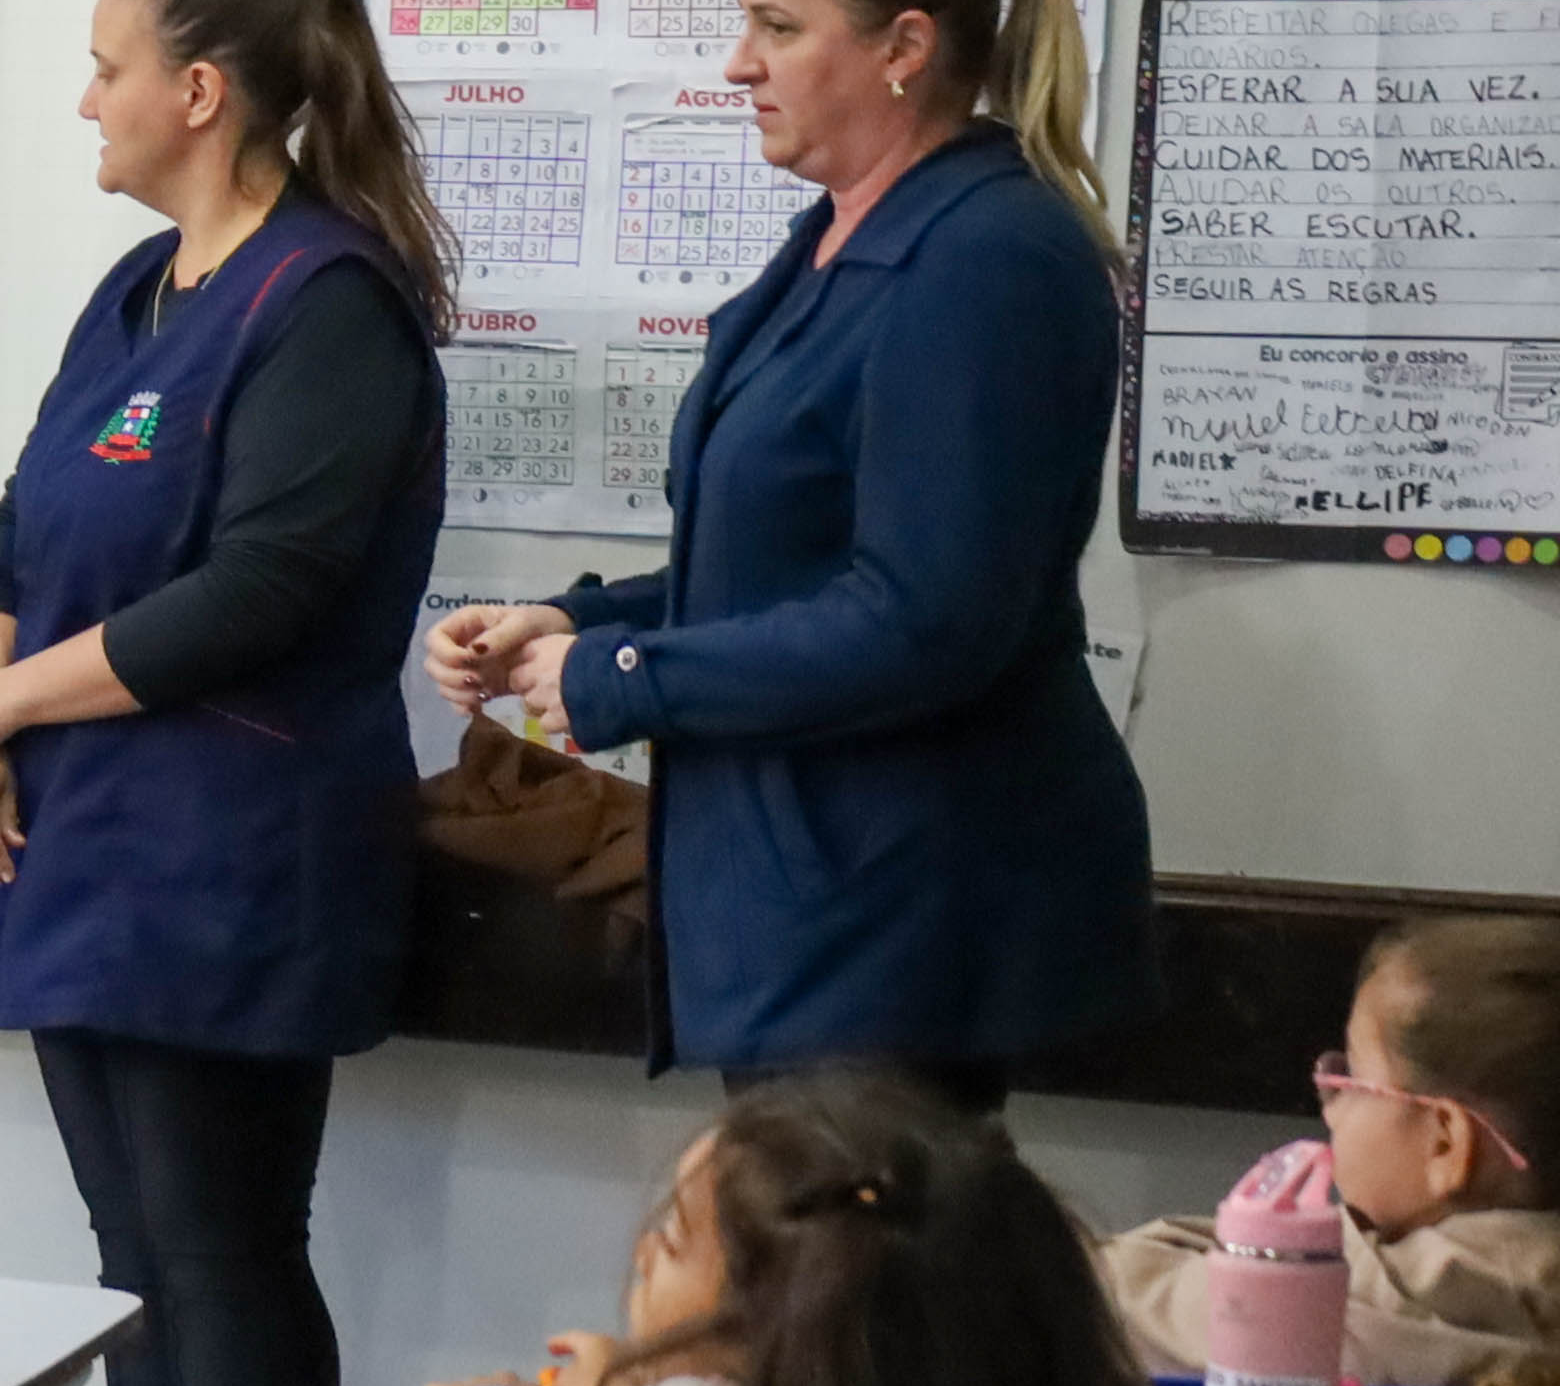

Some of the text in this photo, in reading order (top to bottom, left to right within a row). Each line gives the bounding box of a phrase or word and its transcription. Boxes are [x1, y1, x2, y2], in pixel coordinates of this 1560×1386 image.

[444, 85, 524, 103] JULHO
[1160, 74, 1539, 104] ESPERAR A SUA VEZ.
[1154, 140, 1556, 171] CUIDAR DOS MATERIAIS.
[1161, 209, 1475, 239] SABER ESCUTAR.
[1153, 273, 1437, 304] SEGUIR AS REGRAS
